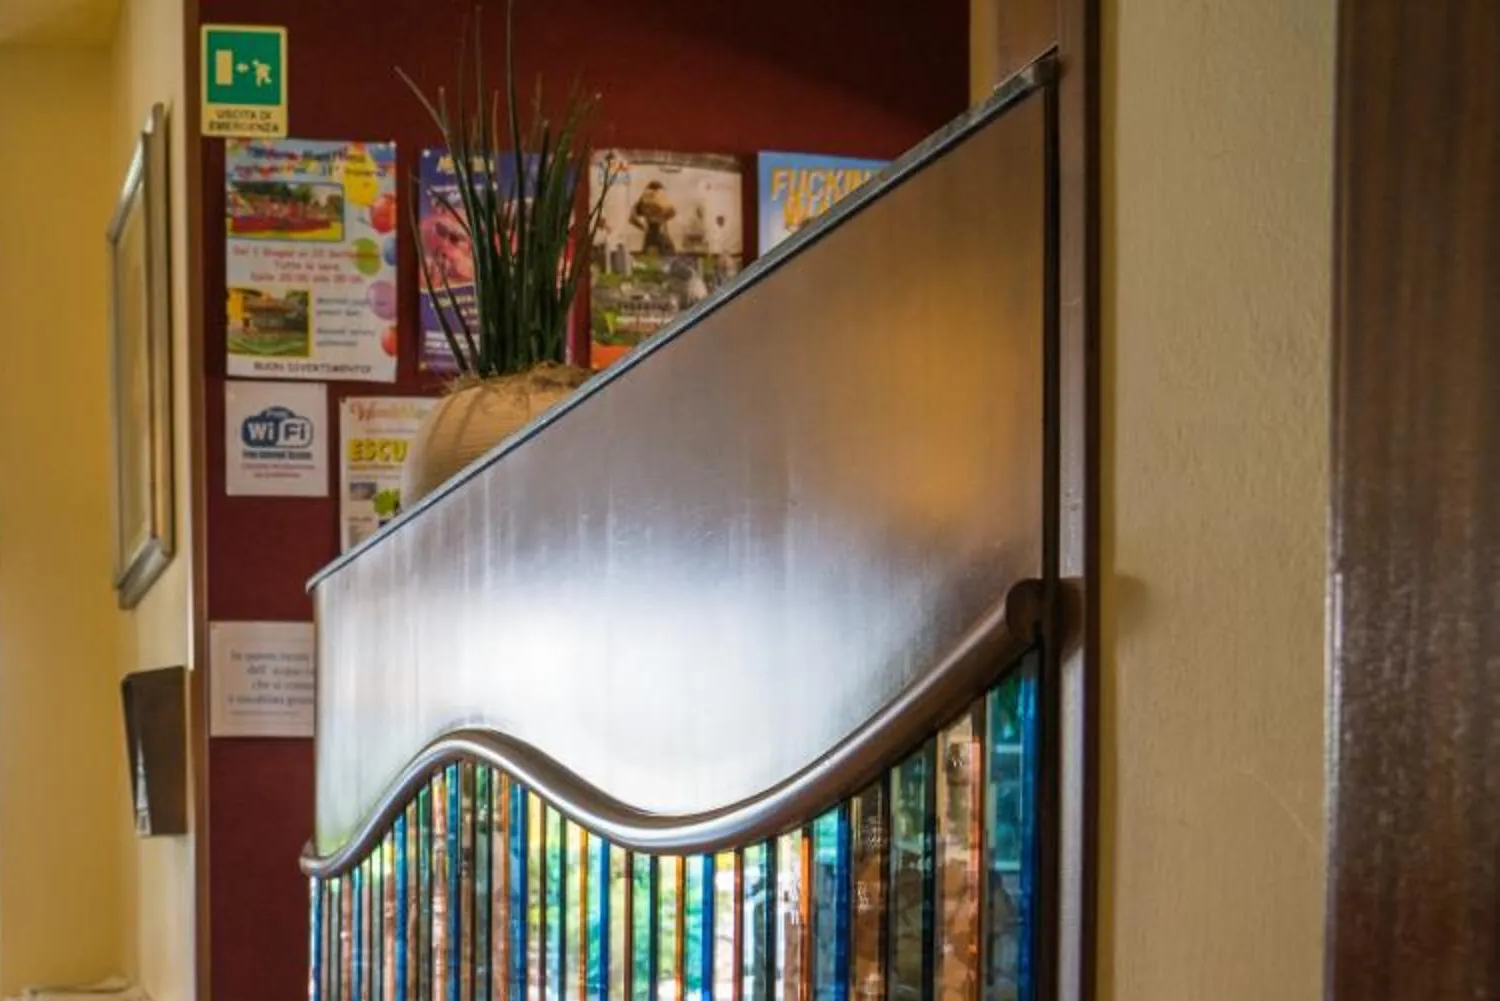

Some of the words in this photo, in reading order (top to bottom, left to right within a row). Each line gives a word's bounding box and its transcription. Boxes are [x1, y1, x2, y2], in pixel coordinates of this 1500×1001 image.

[216, 108, 258, 120] USCITA
[260, 110, 272, 121] DI
[208, 120, 279, 133] EMERGENZA
[771, 167, 875, 205] FUCKIN
